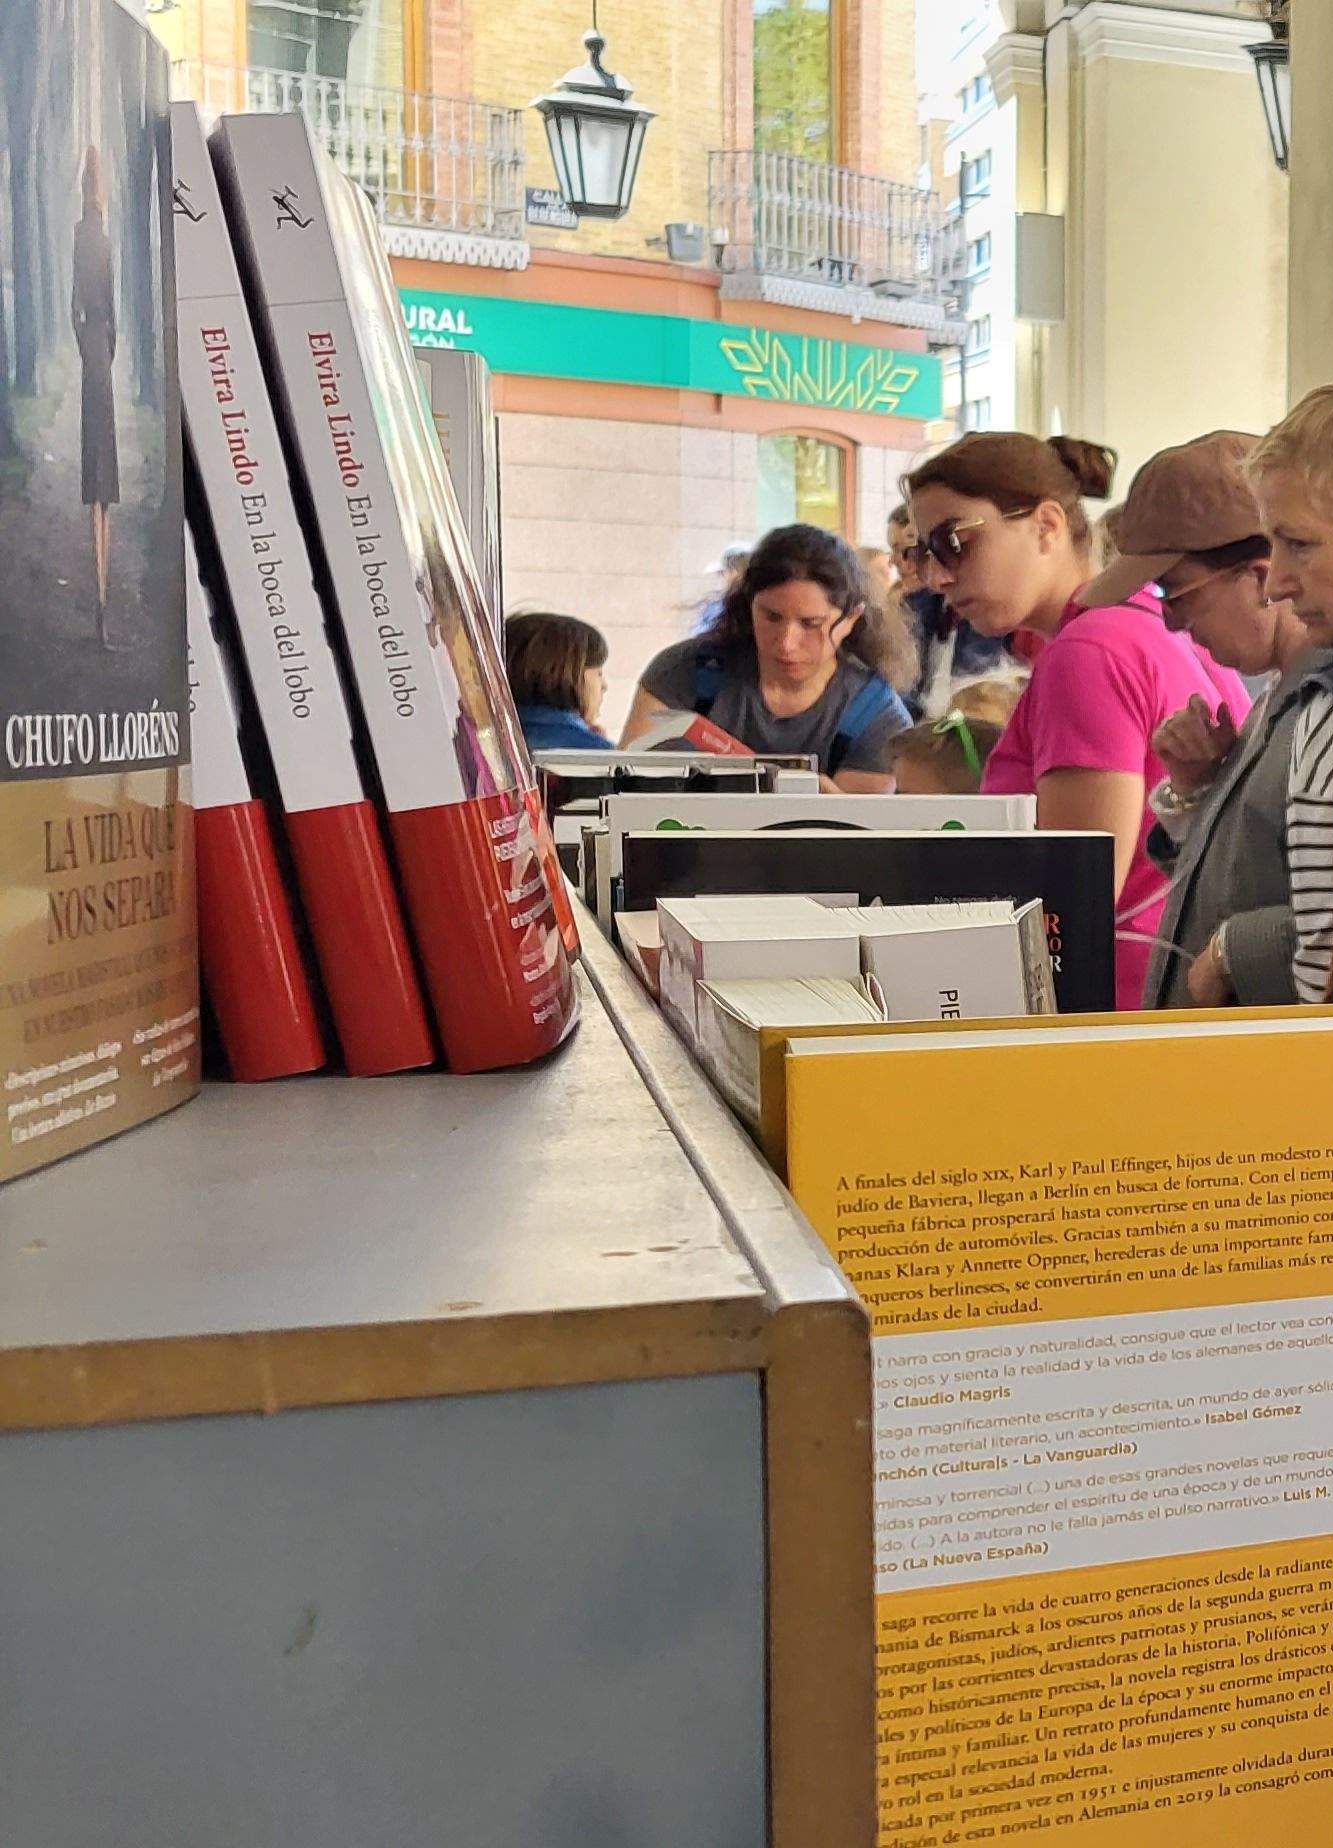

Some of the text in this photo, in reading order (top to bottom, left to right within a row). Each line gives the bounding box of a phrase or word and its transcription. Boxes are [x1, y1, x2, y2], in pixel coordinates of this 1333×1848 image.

[201, 327, 314, 719] Elvira Lindo En la boca del lobo
[307, 329, 417, 718] Elvira Lindo En la boca del lobo
[6, 698, 181, 769] CHUFO LLORÉNS
[44, 820, 80, 873] LA
[84, 811, 138, 865] VIDA
[48, 884, 98, 945] NOS
[836, 1176, 849, 1191] A
[855, 1173, 907, 1190] finales
[911, 1169, 935, 1186] del
[940, 1167, 978, 1187] siglo
[1019, 1161, 1052, 1179] Karl
[1057, 1166, 1067, 1181] y
[1072, 1158, 1105, 1176] Paul
[1110, 1156, 1172, 1174] Effinger,
[1176, 1153, 1211, 1171] hijos
[1213, 1150, 1233, 1166] de
[1237, 1153, 1256, 1164] un
[1260, 1146, 1321, 1163] modesto
[836, 1197, 879, 1218] judío
[908, 1192, 973, 1209] Baviera,
[978, 1189, 1024, 1207] llegan
[1040, 1183, 1088, 1200] Berlín
[1116, 1179, 1158, 1195] busca
[1185, 1174, 1244, 1190] fortuna.
[837, 1219, 905, 1242] pequeña
[911, 1215, 966, 1232] fábrica
[972, 1208, 1055, 1232] prosperará
[1061, 1205, 1100, 1221] hasta
[1105, 1199, 1188, 1217] convertirse
[835, 1211, 1309, 1265] producción automóviles. Gracias también matrimonio
[896, 1262, 940, 1279] Klara
[960, 1258, 1022, 1273] Annette
[1026, 1253, 1089, 1271] Oppner,
[1094, 1244, 1166, 1262] herederas
[1224, 1236, 1303, 1254] importante
[929, 1281, 1010, 1298] berlineses,
[1034, 1269, 1121, 1289] convertirán
[1227, 1255, 1286, 1273] familias
[874, 1296, 1043, 1326] miradas de la ciudad.
[1062, 1559, 1333, 1607] cuatro generaciones radiante
[949, 1621, 1020, 1645] Bismarck
[1065, 1610, 1123, 1628] oscuros
[1203, 1586, 1264, 1610] segunda
[1268, 1583, 1314, 1603] guerra
[990, 1643, 1042, 1664] judíos,
[1046, 1633, 1116, 1653] ardientes
[1120, 1622, 1186, 1646] patriotas
[1202, 1610, 1277, 1634] prusianos,
[1038, 1623, 1318, 1676] devastadoras historia. Polifónica
[1047, 1678, 1105, 1700] precisa,
[1128, 1664, 1176, 1684] novela
[1181, 1658, 1235, 1678] registra
[1264, 1643, 1326, 1663] drásticos
[1035, 1687, 1294, 1742] Un retrato profundamente humano
[1037, 1663, 1333, 1720] Europa enorme impacto
[1146, 1708, 1310, 1746] mujeres conquista
[1039, 1764, 1112, 1785] moderna.
[1078, 1770, 1300, 1822] Alemania 2019 consagró
[1079, 1784, 1116, 1802] 1951
[1135, 1766, 1228, 1792] injustamente
[1231, 1751, 1292, 1774] olvidada
